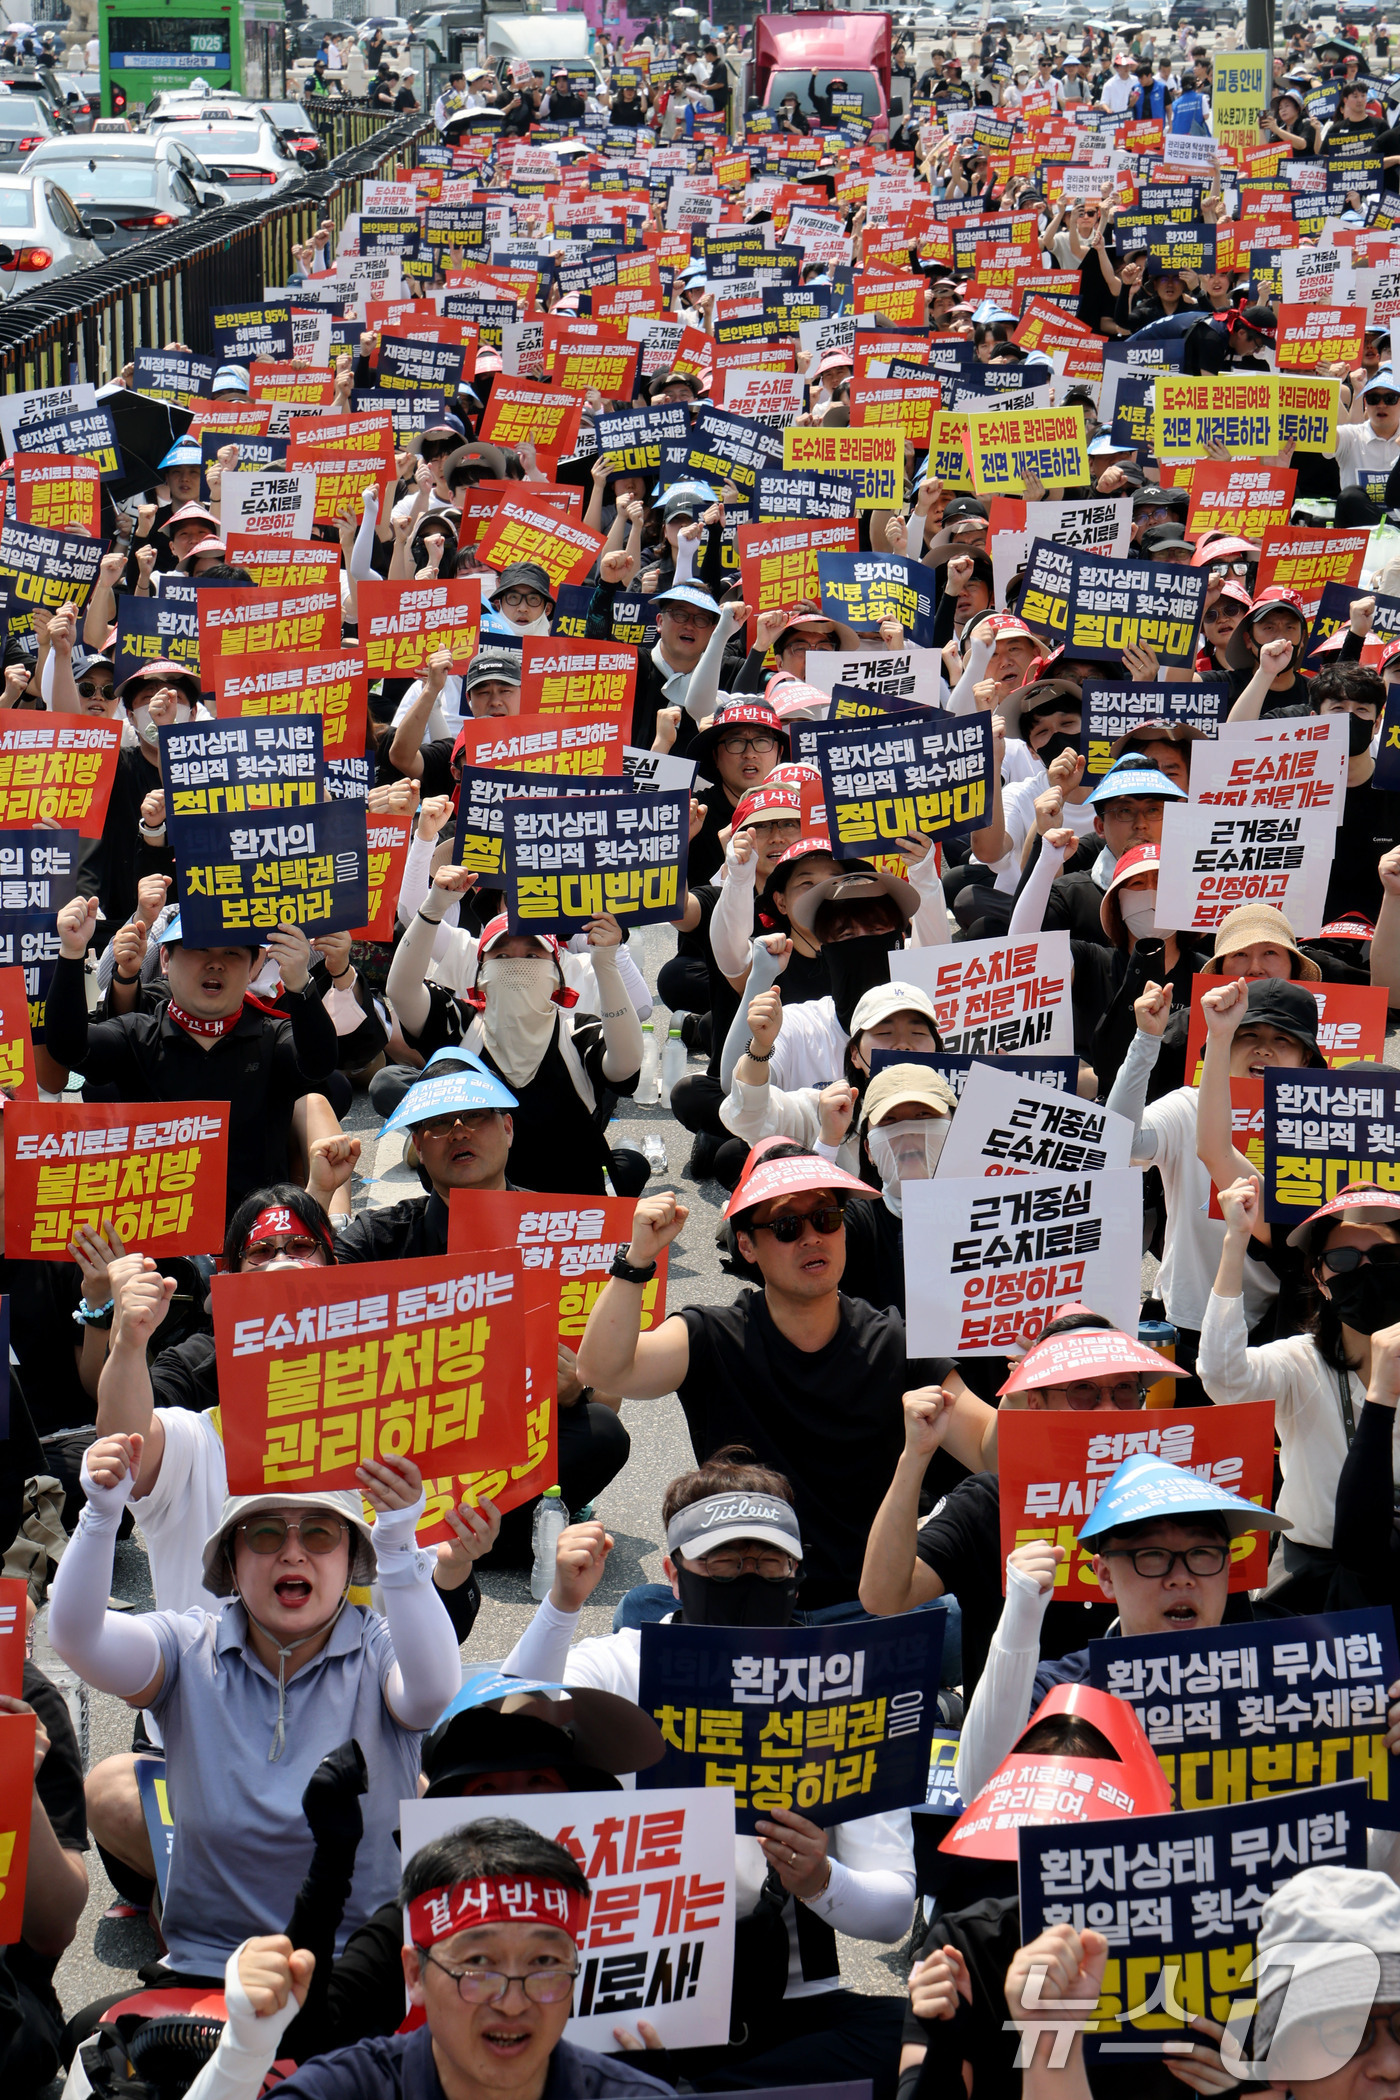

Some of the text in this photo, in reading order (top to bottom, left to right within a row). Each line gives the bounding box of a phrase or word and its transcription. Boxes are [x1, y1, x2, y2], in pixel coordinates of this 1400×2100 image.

[192, 36, 220, 50] 7025
[1217, 69, 1261, 93] 교통안내
[98, 123, 125, 132] TAXI
[1167, 150, 1190, 159] 국민건강
[1168, 141, 1215, 152] 관리급여 탁상행정
[1329, 160, 1381, 171] 본인부담 95%
[1066, 183, 1090, 192] 국민건강
[1067, 175, 1090, 183] 관리급여
[1142, 188, 1192, 199] 환자상태 무시한
[1166, 231, 1197, 243] 환자의
[1239, 234, 1292, 250] 무시한 정책은
[1255, 225, 1281, 237] 현장을
[738, 254, 797, 267] 본인부담 95%
[1150, 243, 1213, 256] 치료 선택권을
[1161, 255, 1202, 269] 보장하라
[1301, 251, 1338, 264] 근거중심
[1295, 264, 1341, 278] 도수치료를
[783, 293, 814, 305] 환자의
[214, 309, 288, 328] 본인부담 95%
[1306, 311, 1341, 326] 현장을
[235, 327, 272, 341] 혜택은
[1284, 324, 1356, 340] 무시한 정책은
[224, 339, 286, 358] 보험사에게!
[384, 344, 461, 366] 재정투입 없는
[559, 345, 601, 356] 도수치료로
[1277, 338, 1362, 364] 탁상행정
[139, 356, 213, 380] 재정투입 없는
[565, 356, 629, 374] 불법처방
[493, 388, 544, 405] 도수치료로
[745, 378, 793, 396] 도수치료
[1163, 385, 1271, 411] 도수치료 관리급여화
[497, 403, 565, 426] 불법처방
[599, 410, 685, 434] 환자상태 무시한
[19, 414, 108, 450] 환자상태 무시한
[600, 425, 686, 449] 획일적 횟수제한
[700, 415, 758, 444] 재정투입
[978, 417, 1077, 446] 도수치료 관리급여화
[1163, 416, 1271, 447] 전면 재검토하라
[792, 437, 897, 462] 도수치료 관리급여화
[981, 452, 1009, 483] 전면
[1227, 472, 1270, 489] 현장을
[250, 477, 299, 496] 근거중심
[760, 478, 853, 499] 환자상태 무시한
[1200, 488, 1285, 508] 무시한 정책은
[241, 496, 302, 515] 도수치료를
[759, 496, 801, 514] 획일적
[1061, 505, 1116, 528] 근거중심
[246, 513, 295, 533] 인정하고
[1267, 536, 1366, 557] 도수치료로 둔갑하는
[853, 562, 908, 585] 환자의
[1273, 554, 1354, 582] 불법처방
[826, 581, 865, 604] 치료
[1078, 566, 1202, 597] 환자상태 무시한
[205, 591, 337, 628] 도수치료로 둔갑하는
[398, 587, 448, 611] 현장을
[1076, 589, 1198, 620] 획일적 횟수제한
[369, 604, 469, 636] 무시한 정책은
[1072, 614, 1194, 656] 절대반대
[1089, 693, 1220, 714] 환자상태 무시한
[167, 726, 314, 759] 환자상태 무시한
[828, 725, 984, 770] 환자상태 무시한
[170, 753, 316, 785] 획일적 횟수제한
[832, 754, 985, 798] 획일적 횟수제한
[1227, 750, 1319, 786] 도수치료
[513, 805, 681, 841] 환자상태 무시한
[835, 779, 986, 844] 절대반대
[229, 822, 315, 861] 환자의
[1210, 818, 1301, 844] 근거중심
[515, 834, 680, 870] 획일적 횟수제한
[1192, 845, 1305, 873] 도수치료를
[185, 850, 360, 897] 치료 선택권을
[515, 865, 678, 919] 절대반대
[1196, 874, 1290, 900] 인정하고
[222, 889, 334, 930] 보장하라
[935, 943, 1038, 998] 도수치료
[964, 976, 1064, 1027] 전문가는
[1275, 1083, 1385, 1118] 환자상태
[15, 1115, 221, 1161] 도수치료로 둔갑하는
[1275, 1118, 1355, 1152] 획일적
[36, 1147, 202, 1206] 불법처방
[970, 1180, 1092, 1232] 근거중심
[516, 1209, 606, 1243] 현장을
[950, 1218, 1102, 1274] 도수치료를
[962, 1260, 1086, 1312] 인정하고
[232, 1271, 514, 1358] 도수치료로 둔갑하는
[266, 1316, 491, 1419] 불법처방
[262, 1383, 485, 1484] 관리하라
[1086, 1424, 1195, 1475] 현장을
[701, 1499, 780, 1528] Titleist
[731, 1650, 865, 1705] 환자의
[1106, 1632, 1383, 1700] 환자상태 무시한
[1238, 1684, 1390, 1738] 횟수제한
[654, 1690, 924, 1759] 치료 선택권을
[1017, 1766, 1135, 1815] 치료받을 권리
[988, 1787, 1088, 1821] 관리급여,
[1039, 1810, 1350, 1896] 환자상태 무시한
[423, 1881, 570, 1936] 결사반대
